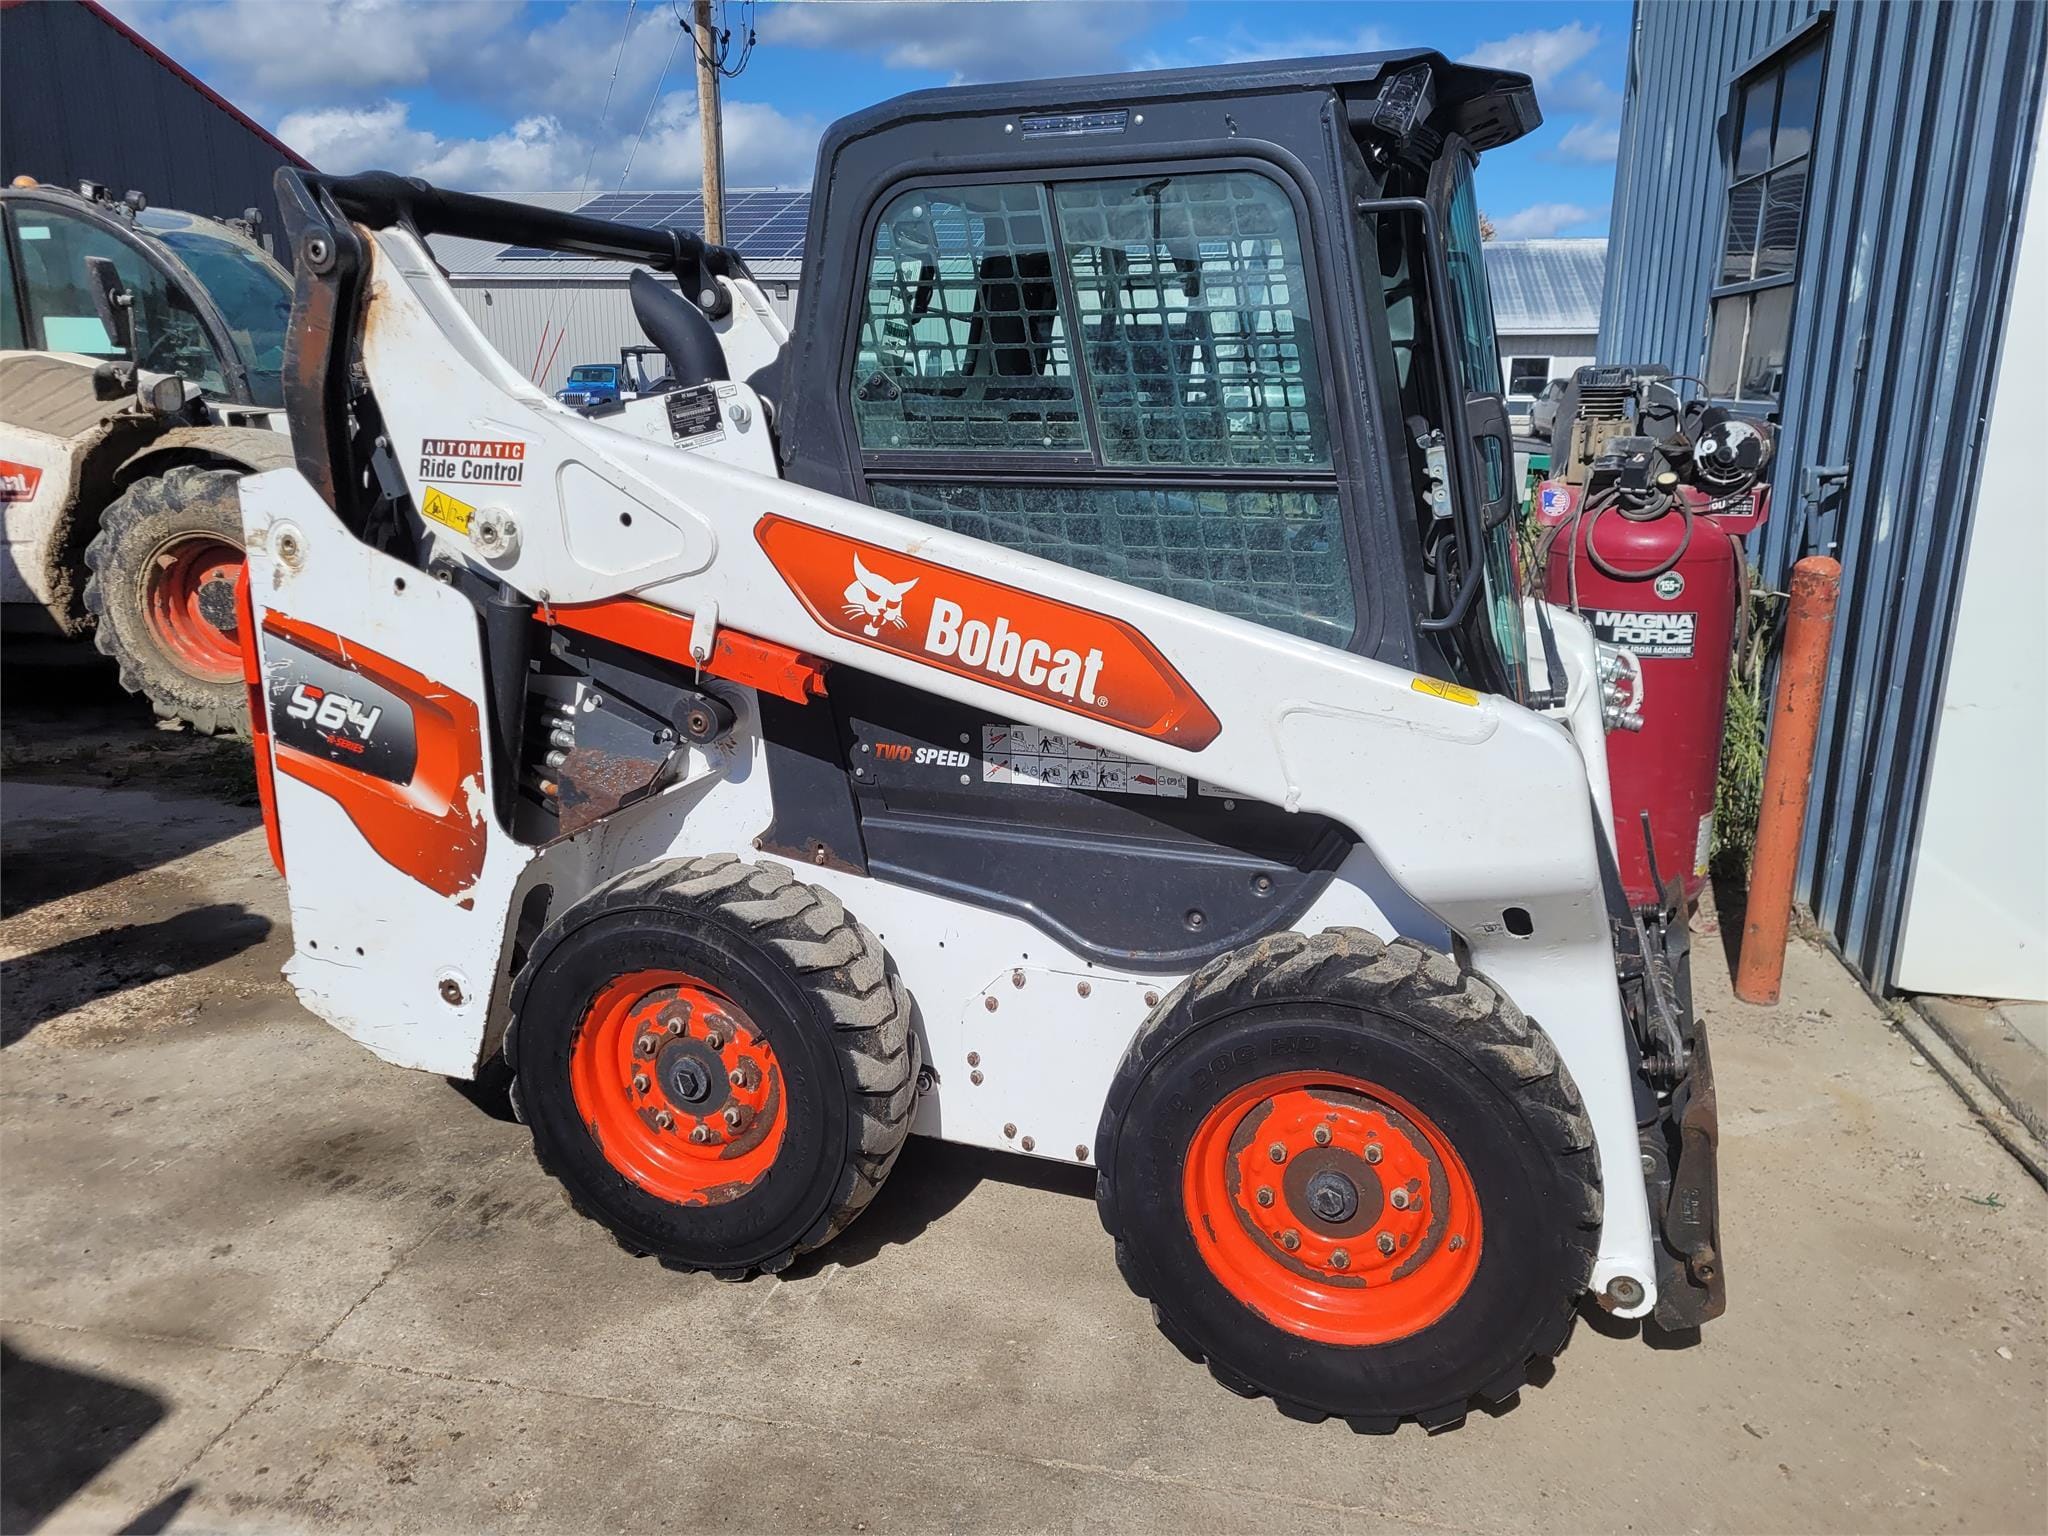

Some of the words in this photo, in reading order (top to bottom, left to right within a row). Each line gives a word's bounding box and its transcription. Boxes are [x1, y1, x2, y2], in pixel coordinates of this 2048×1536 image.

[425, 441, 521, 458] AUTOMATIC
[420, 458, 456, 478] Ride
[461, 460, 523, 481] Control
[1595, 611, 1694, 629] MAGNA
[1612, 628, 1693, 644] FORCE
[924, 597, 1104, 704] Bobcat
[1630, 645, 1652, 653] IRON
[1653, 645, 1692, 654] MACHINE
[286, 684, 382, 740] S64
[875, 743, 913, 762] TWO
[914, 747, 970, 768] SPEED
